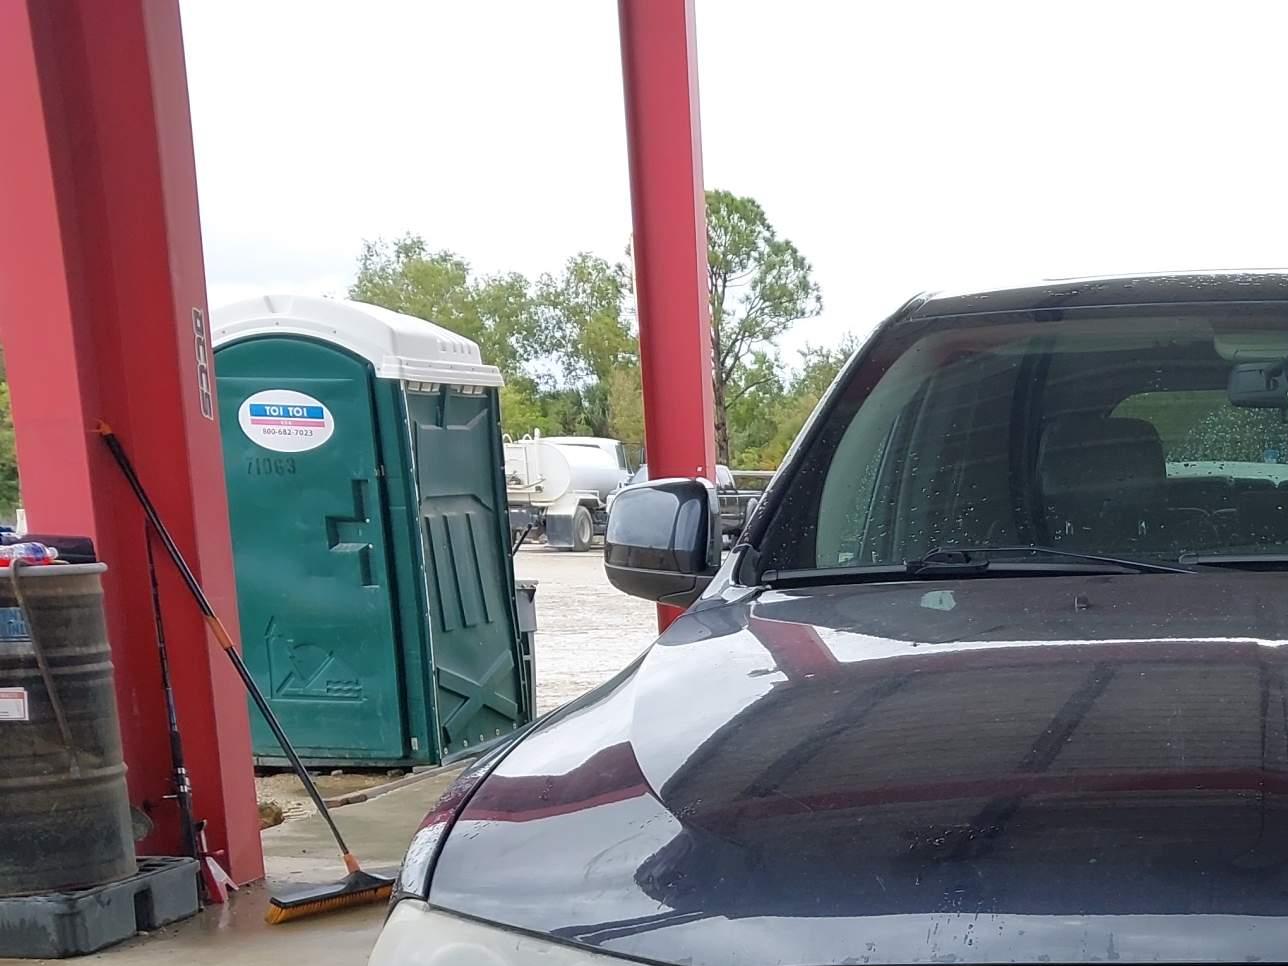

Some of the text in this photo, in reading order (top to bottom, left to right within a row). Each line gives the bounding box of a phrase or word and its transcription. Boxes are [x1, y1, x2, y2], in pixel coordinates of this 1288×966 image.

[264, 406, 307, 417] TOI TOI
[262, 428, 313, 437] 800-682-7023
